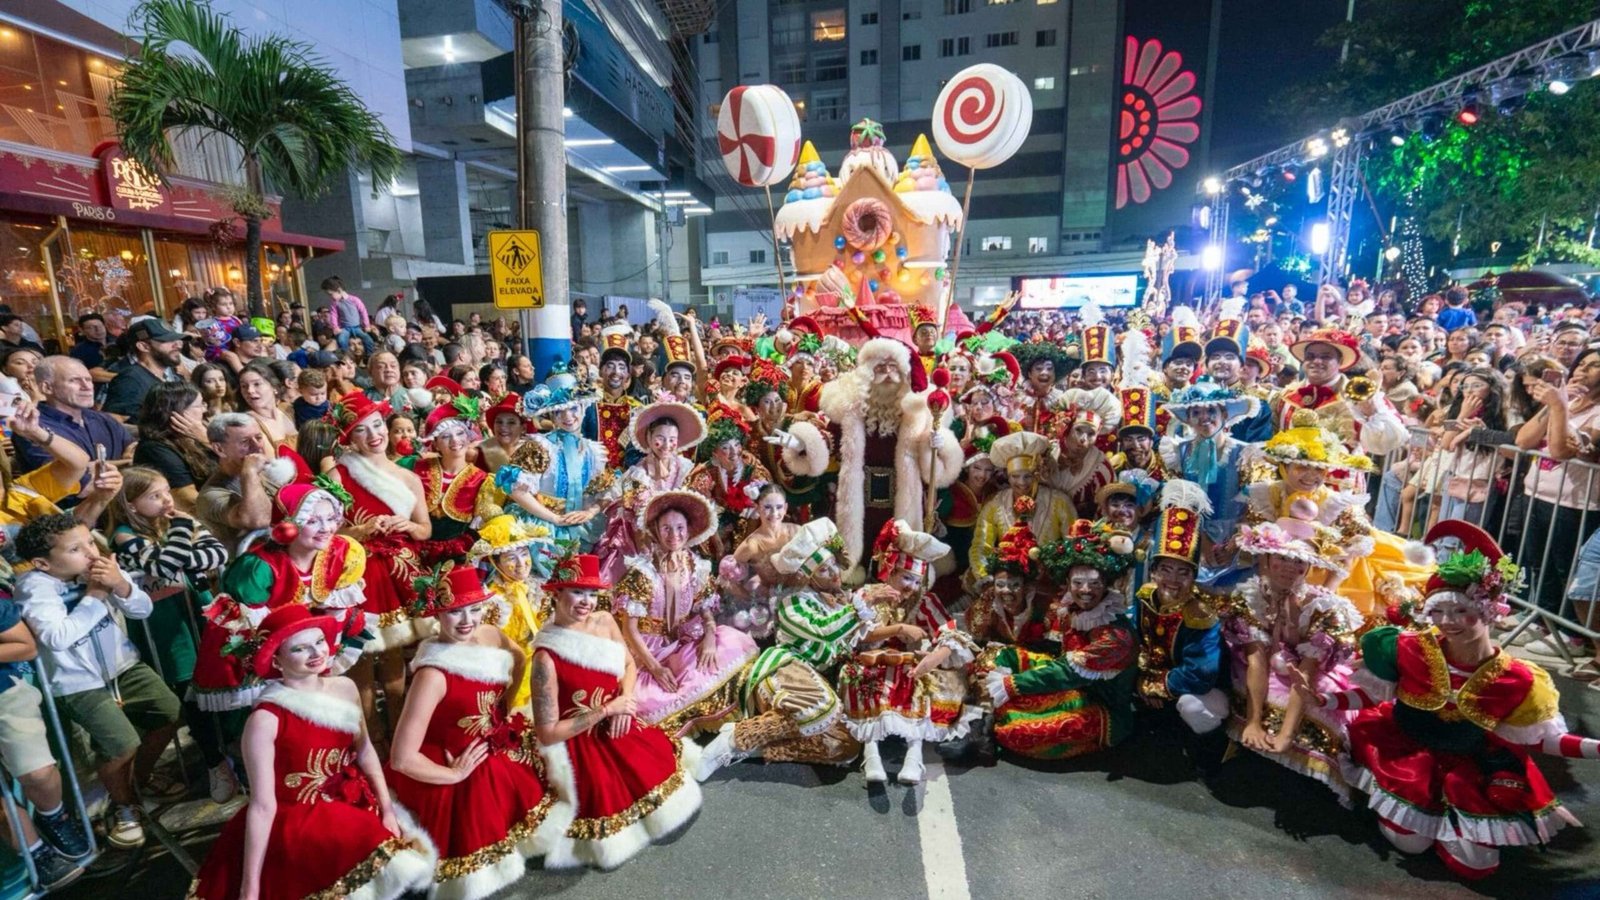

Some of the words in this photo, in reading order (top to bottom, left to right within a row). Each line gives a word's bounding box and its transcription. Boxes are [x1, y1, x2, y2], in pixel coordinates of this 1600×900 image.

[106, 208, 116, 220] 6
[505, 277, 531, 285] FAIXA
[499, 287, 539, 295] ELEVADA
